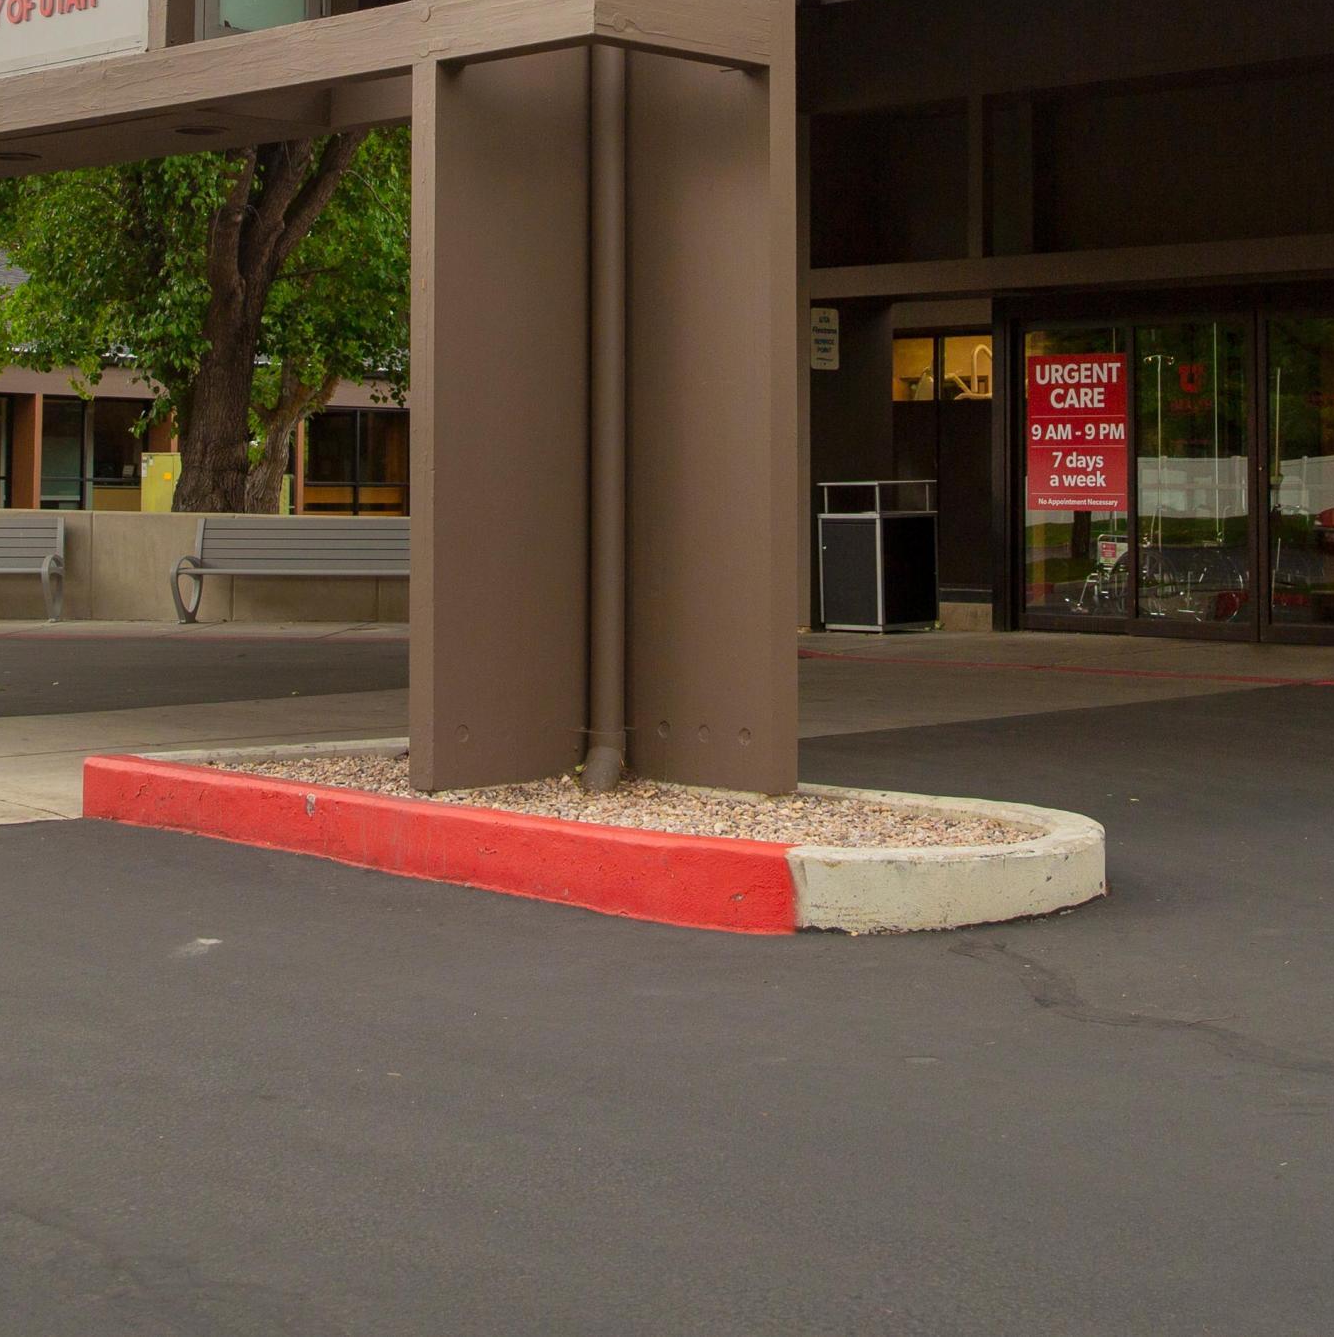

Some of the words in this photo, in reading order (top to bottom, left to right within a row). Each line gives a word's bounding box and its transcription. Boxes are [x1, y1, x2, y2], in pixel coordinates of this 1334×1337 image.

[1035, 363, 1120, 385] URGENT
[1050, 388, 1105, 408] CARE
[1031, 424, 1041, 440] 9
[1045, 424, 1071, 439] AM
[1085, 424, 1095, 439] 9
[1100, 423, 1124, 439] PM
[1052, 452, 1062, 467] 7
[1066, 452, 1104, 471] days
[1050, 475, 1059, 486] a
[1063, 471, 1106, 487] week
[1048, 498, 1086, 506] Appointment
[1088, 499, 1118, 507] Necessary
